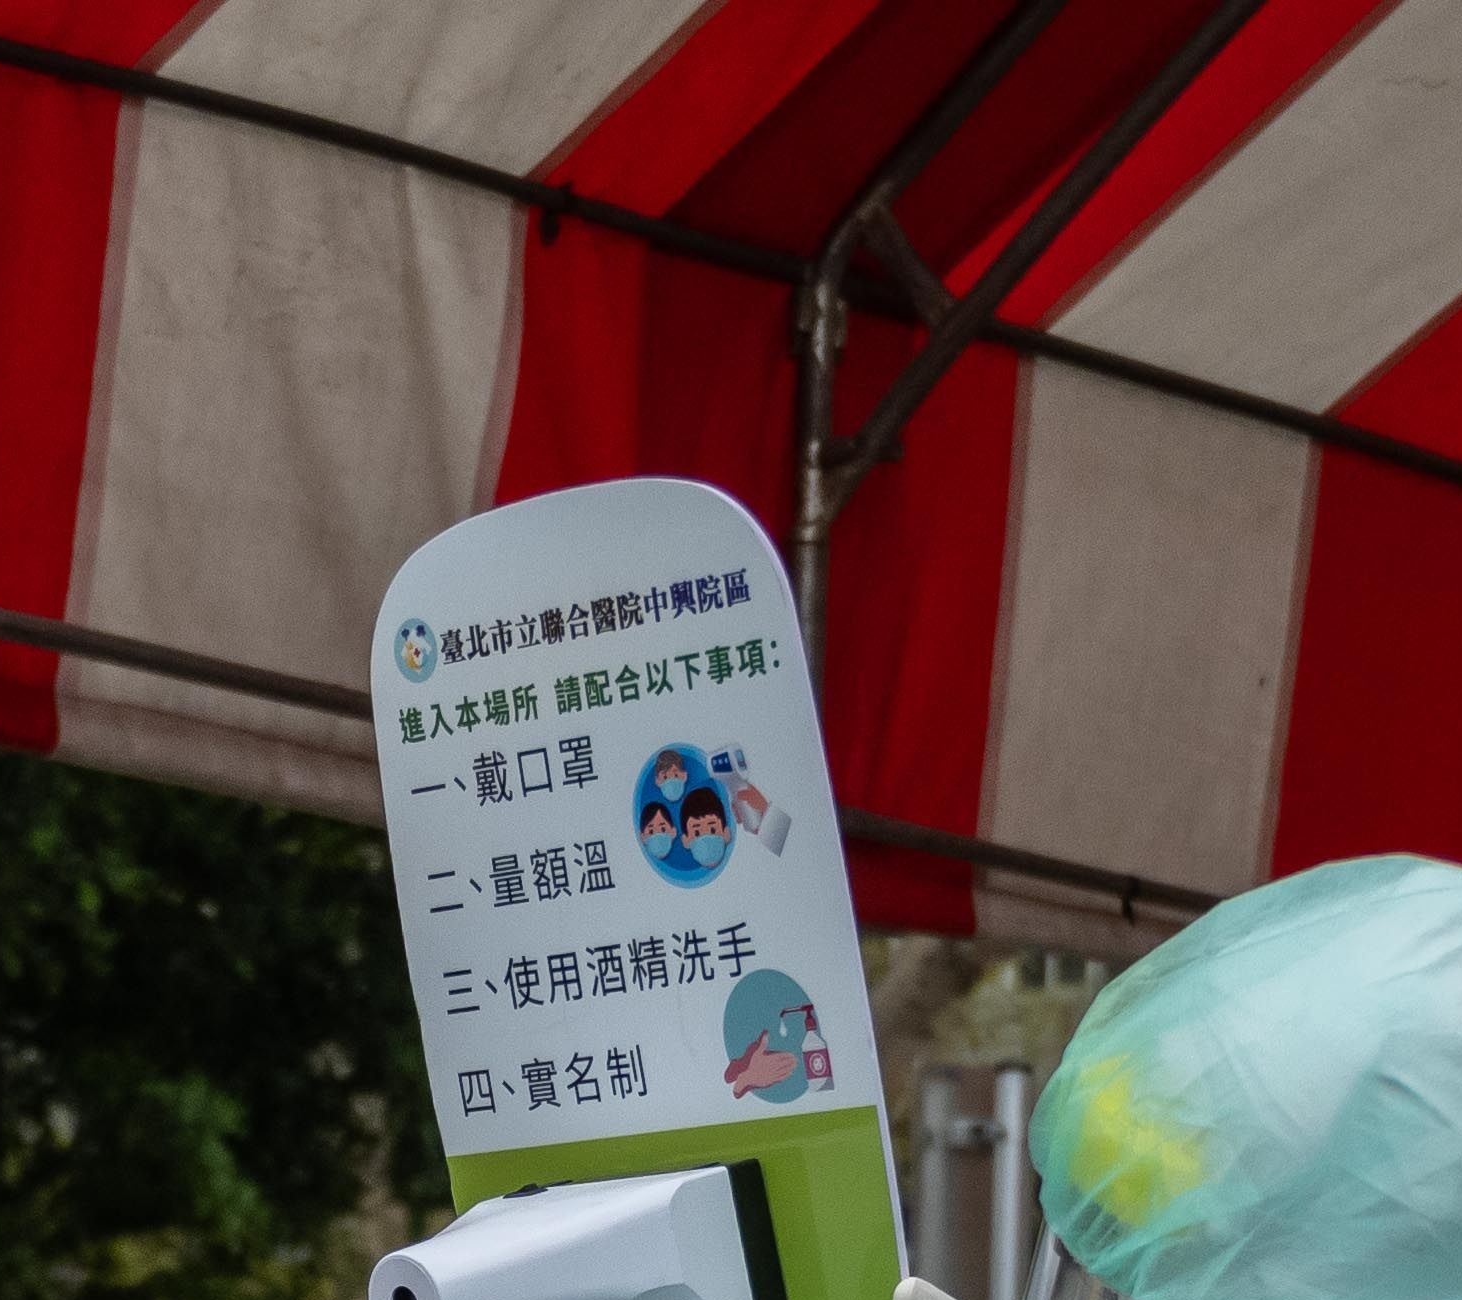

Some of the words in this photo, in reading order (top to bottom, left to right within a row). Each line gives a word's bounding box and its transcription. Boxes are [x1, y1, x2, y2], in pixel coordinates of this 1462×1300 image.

[440, 568, 752, 666] 臺北市立聯合醫院中興院區
[398, 682, 541, 745] 進入本場所
[410, 735, 599, 808] 一、戴口罩
[426, 840, 617, 914] 二、量額溫
[442, 921, 758, 1016] 三、使用酒精洗手
[457, 1044, 649, 1118] 四、實名制
